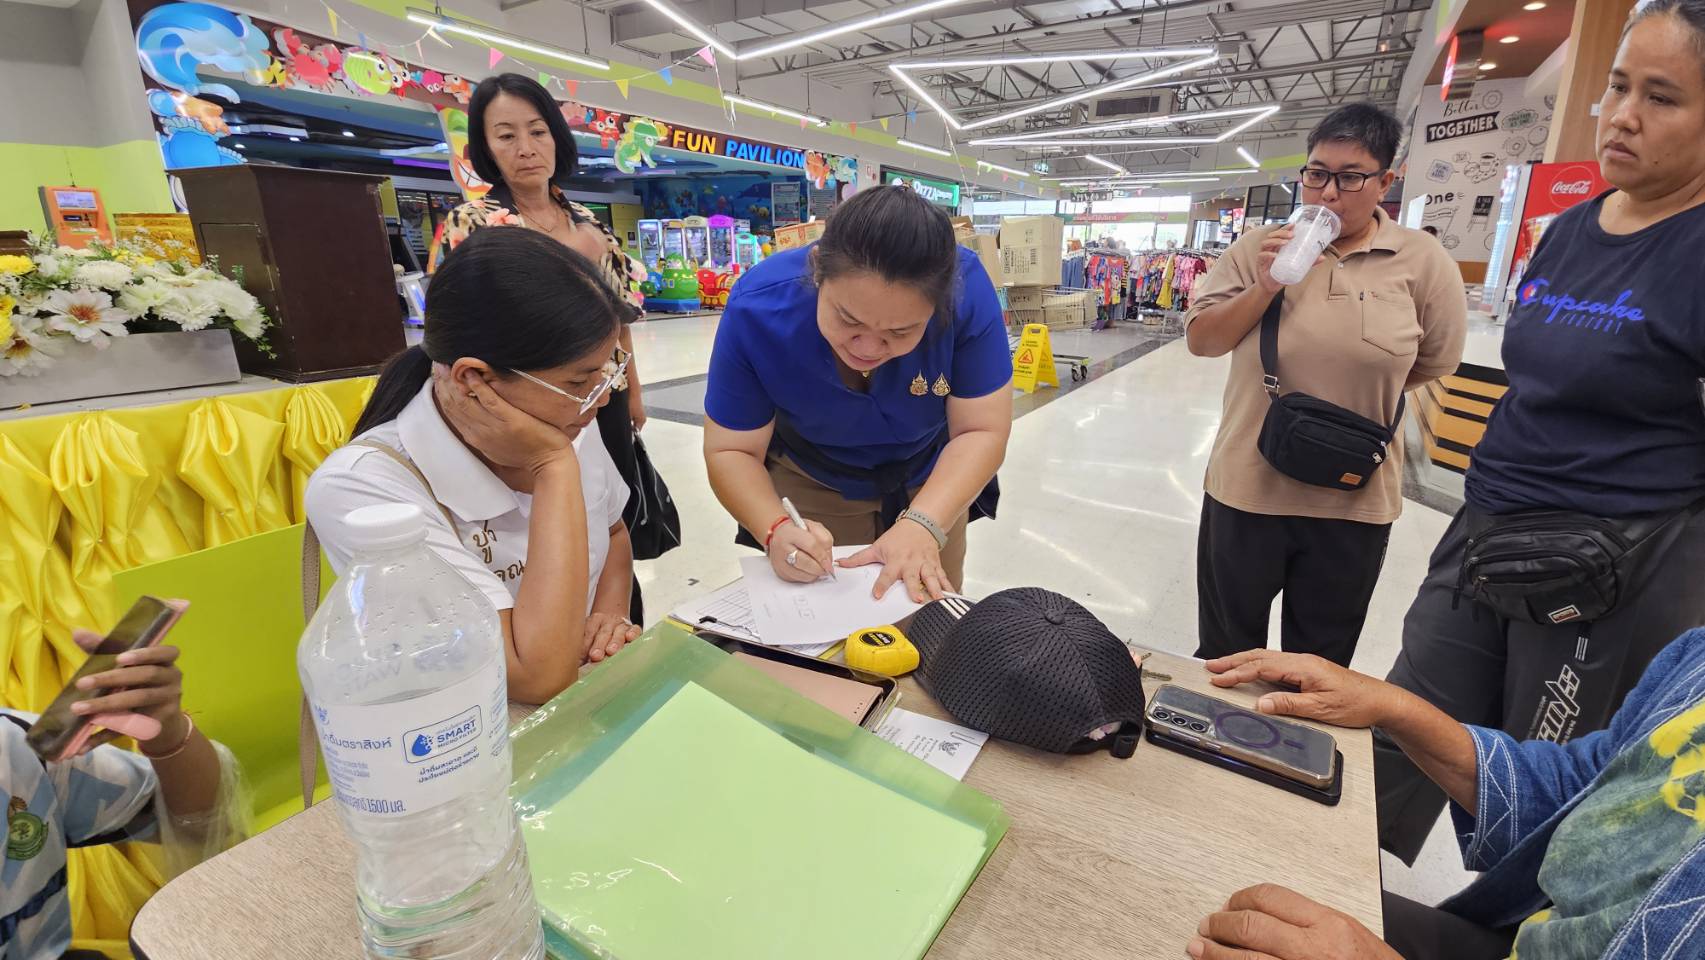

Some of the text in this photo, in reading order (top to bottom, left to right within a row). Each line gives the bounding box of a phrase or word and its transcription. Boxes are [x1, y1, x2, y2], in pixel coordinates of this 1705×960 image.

[1428, 115, 1494, 140] TOGETHER
[673, 129, 805, 169] FUN PAVILION
[1518, 278, 1645, 324] Cupcake
[437, 719, 477, 743] SMART
[366, 798, 389, 814] 1500
